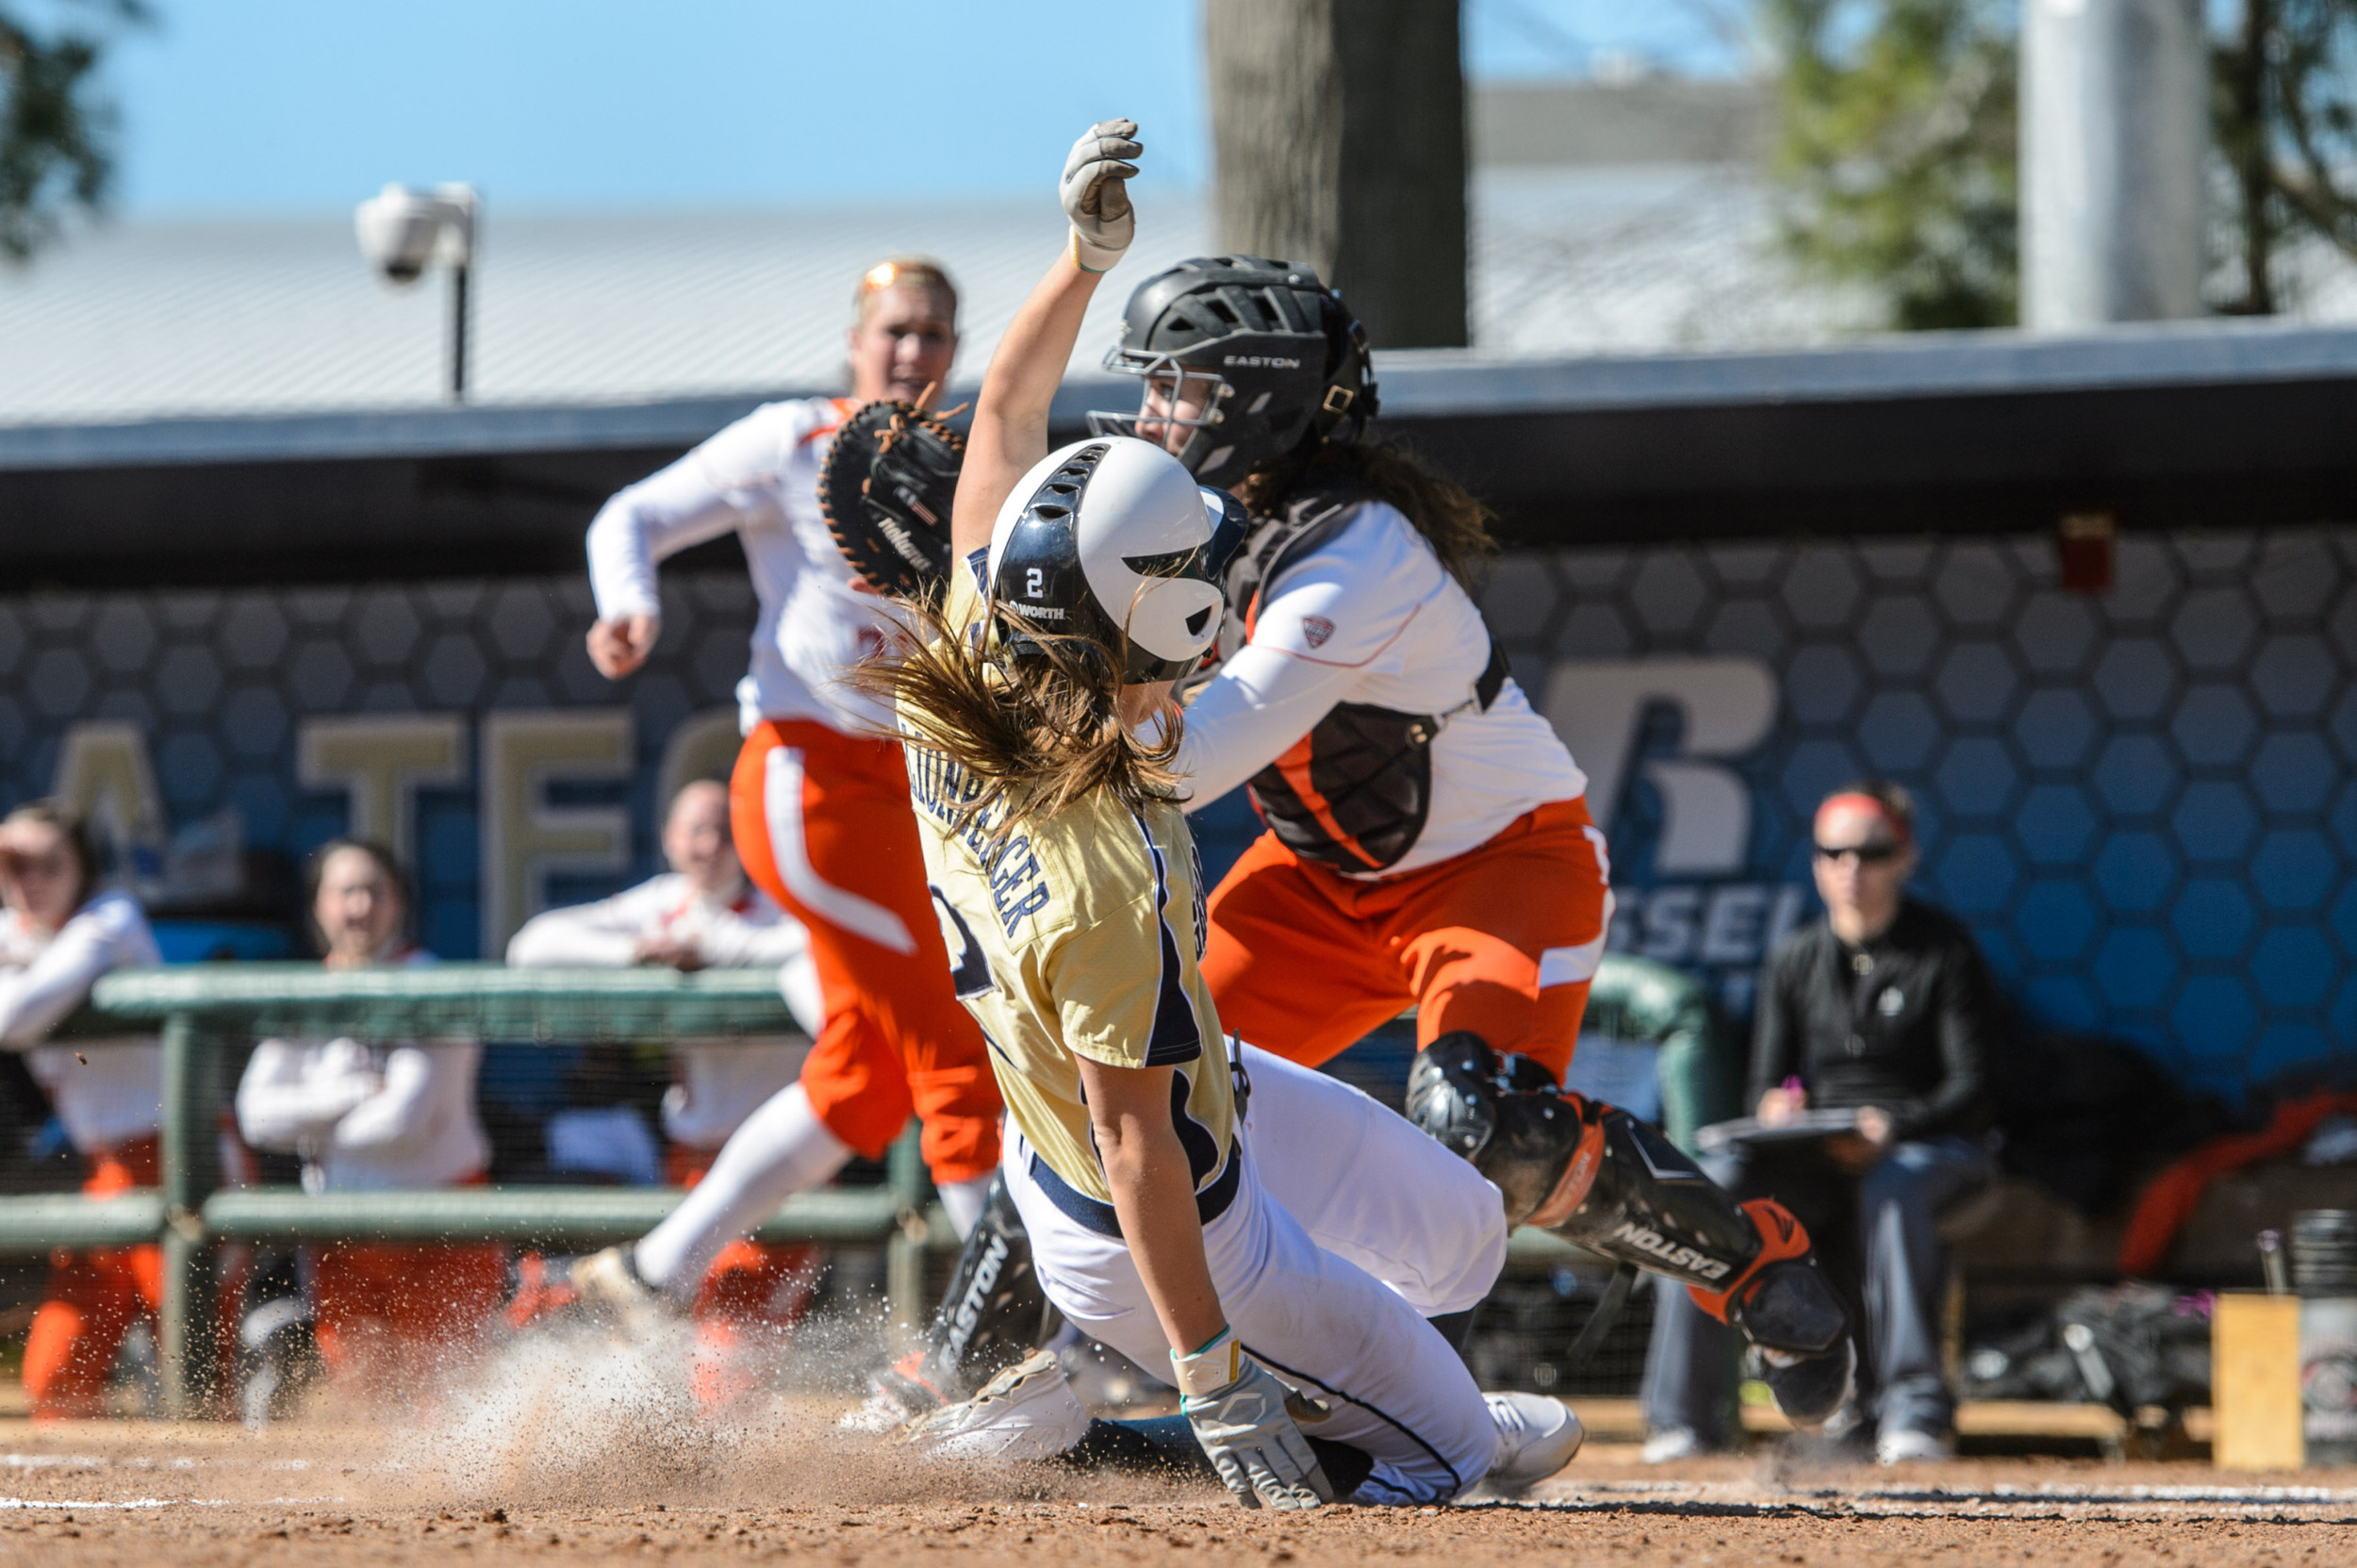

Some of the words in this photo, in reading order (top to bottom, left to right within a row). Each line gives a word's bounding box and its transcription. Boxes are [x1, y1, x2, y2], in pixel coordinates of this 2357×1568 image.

[1224, 355, 1301, 369] EASTON
[1026, 568, 1044, 599] 2
[1017, 602, 1066, 620] WORTH
[1613, 1221, 1732, 1280] EASTON
